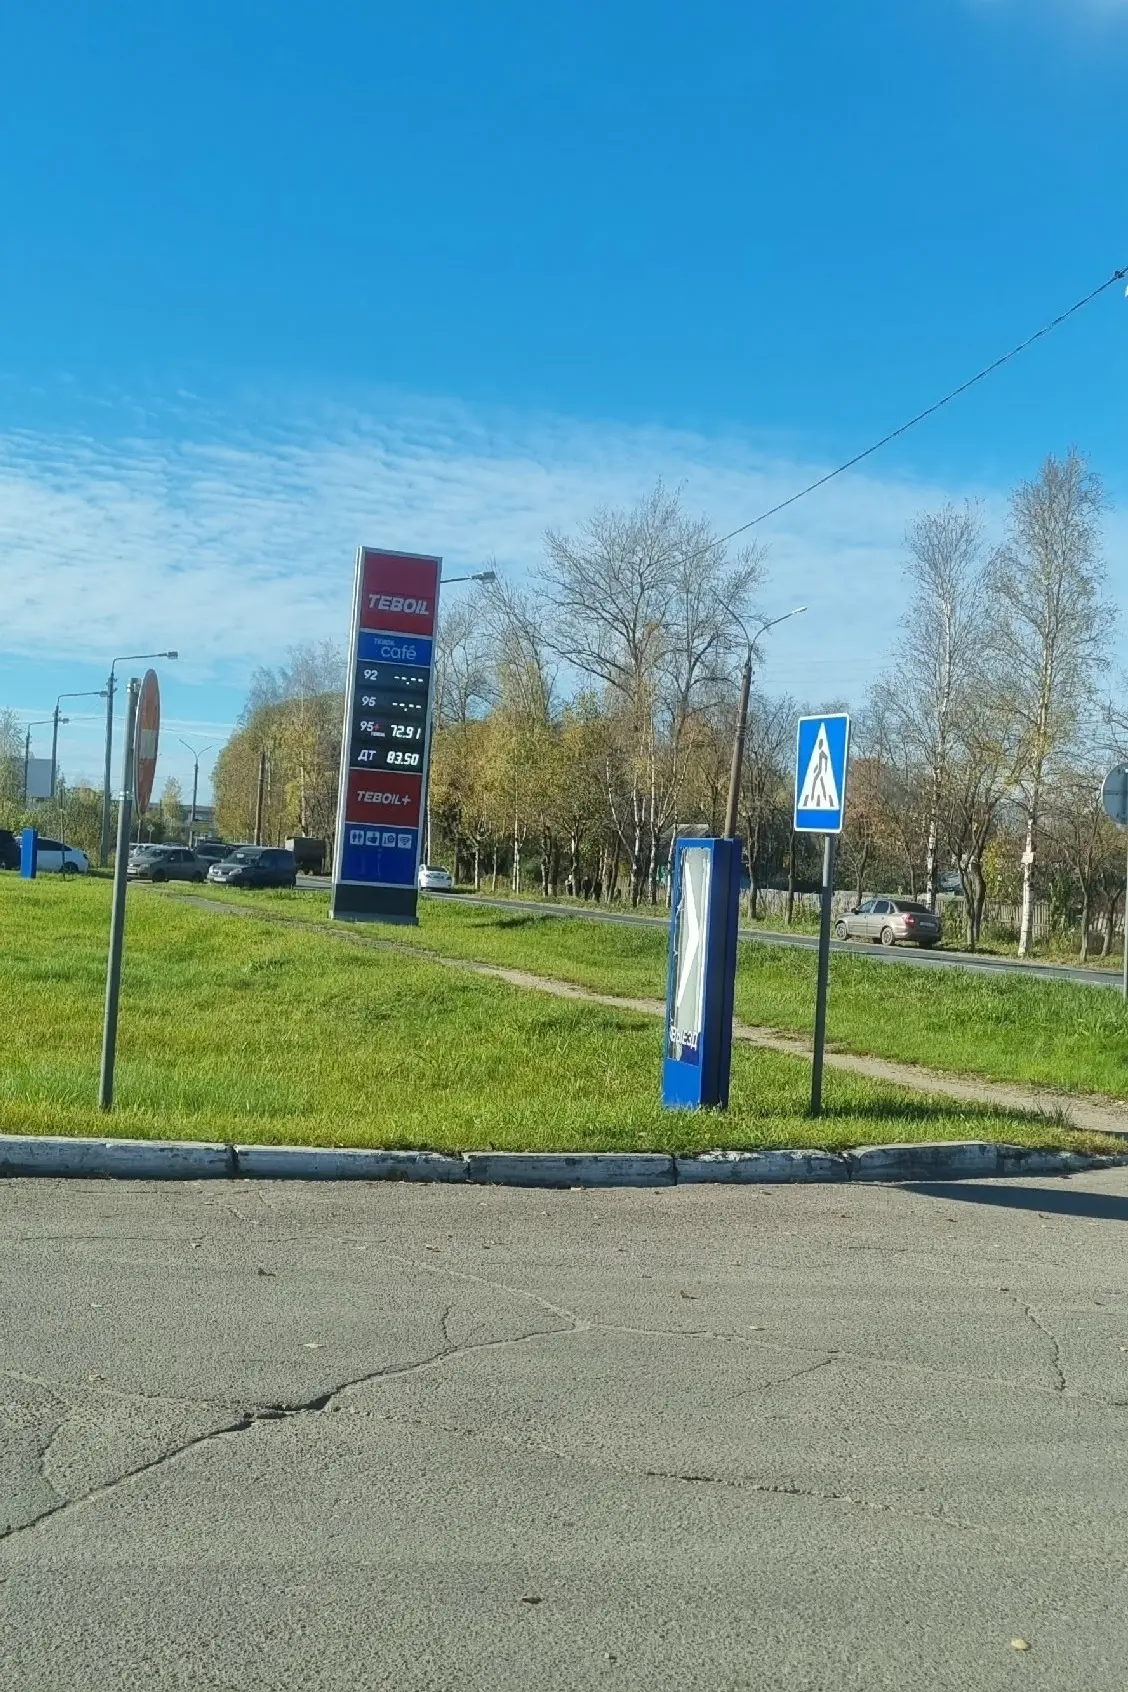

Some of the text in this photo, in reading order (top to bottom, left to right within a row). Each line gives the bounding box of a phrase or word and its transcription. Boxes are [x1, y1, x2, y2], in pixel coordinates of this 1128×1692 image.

[368, 594, 429, 615] TEBOIL
[381, 645, 417, 660] café
[363, 669, 378, 681] 92
[361, 696, 376, 707] 95
[390, 724, 421, 740] 72.91
[357, 749, 420, 766] ДТ 83.50
